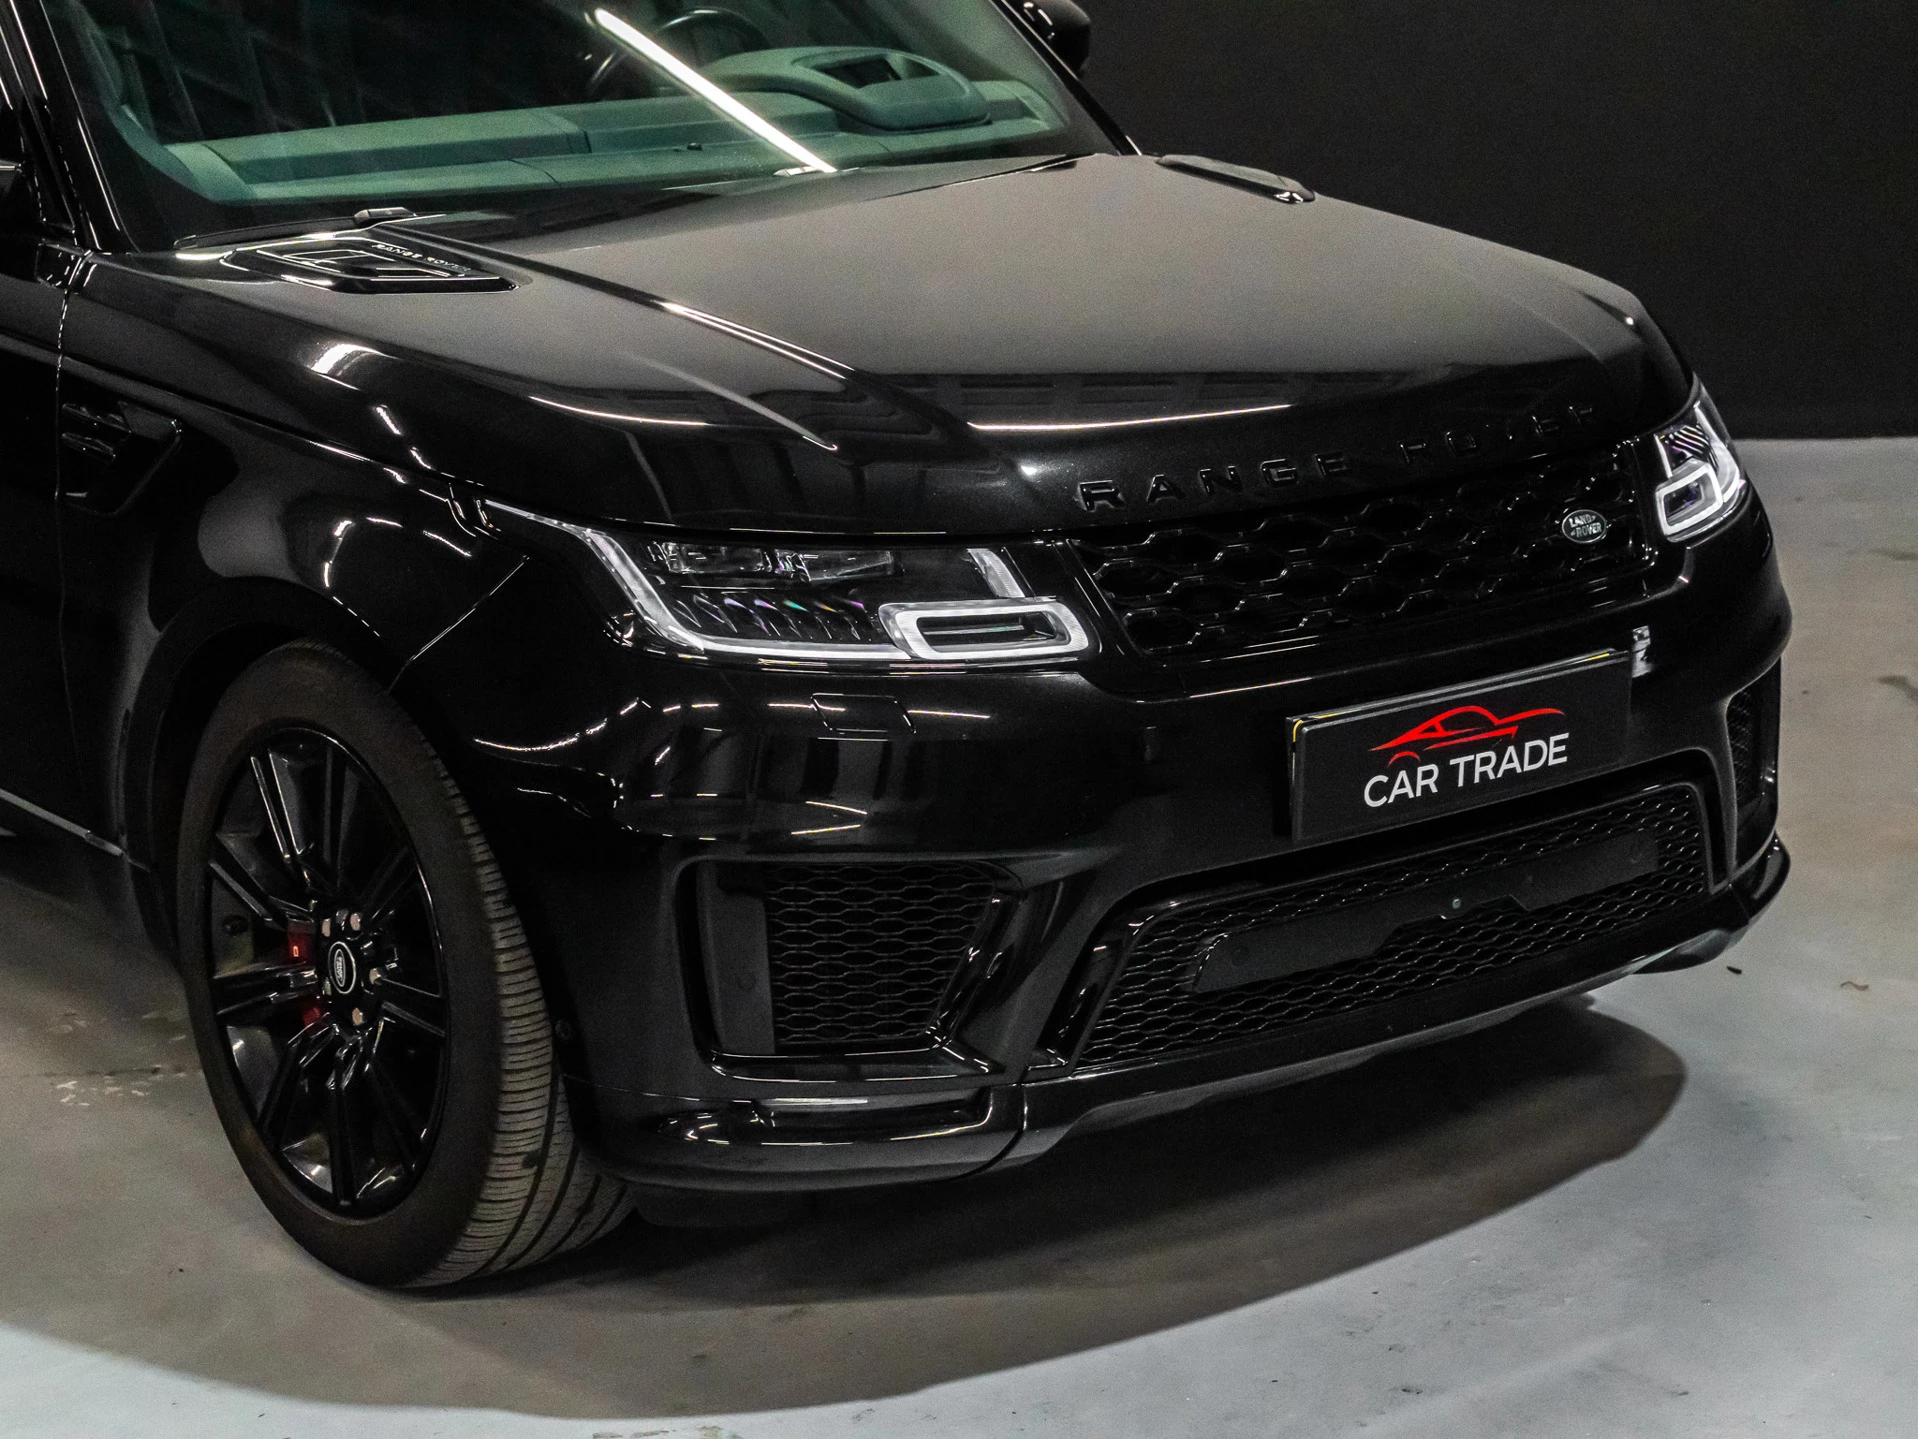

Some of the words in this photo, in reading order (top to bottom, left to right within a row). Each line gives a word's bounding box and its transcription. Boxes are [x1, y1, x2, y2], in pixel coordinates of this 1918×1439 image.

[371, 243, 424, 259] RANGE
[1076, 451, 1349, 512] RANGE
[1396, 403, 1596, 464] ROER
[1569, 514, 1592, 528] LAND
[1576, 522, 1602, 537] ROVER
[1363, 763, 1440, 808] CAR
[1449, 732, 1570, 788] TRADE
